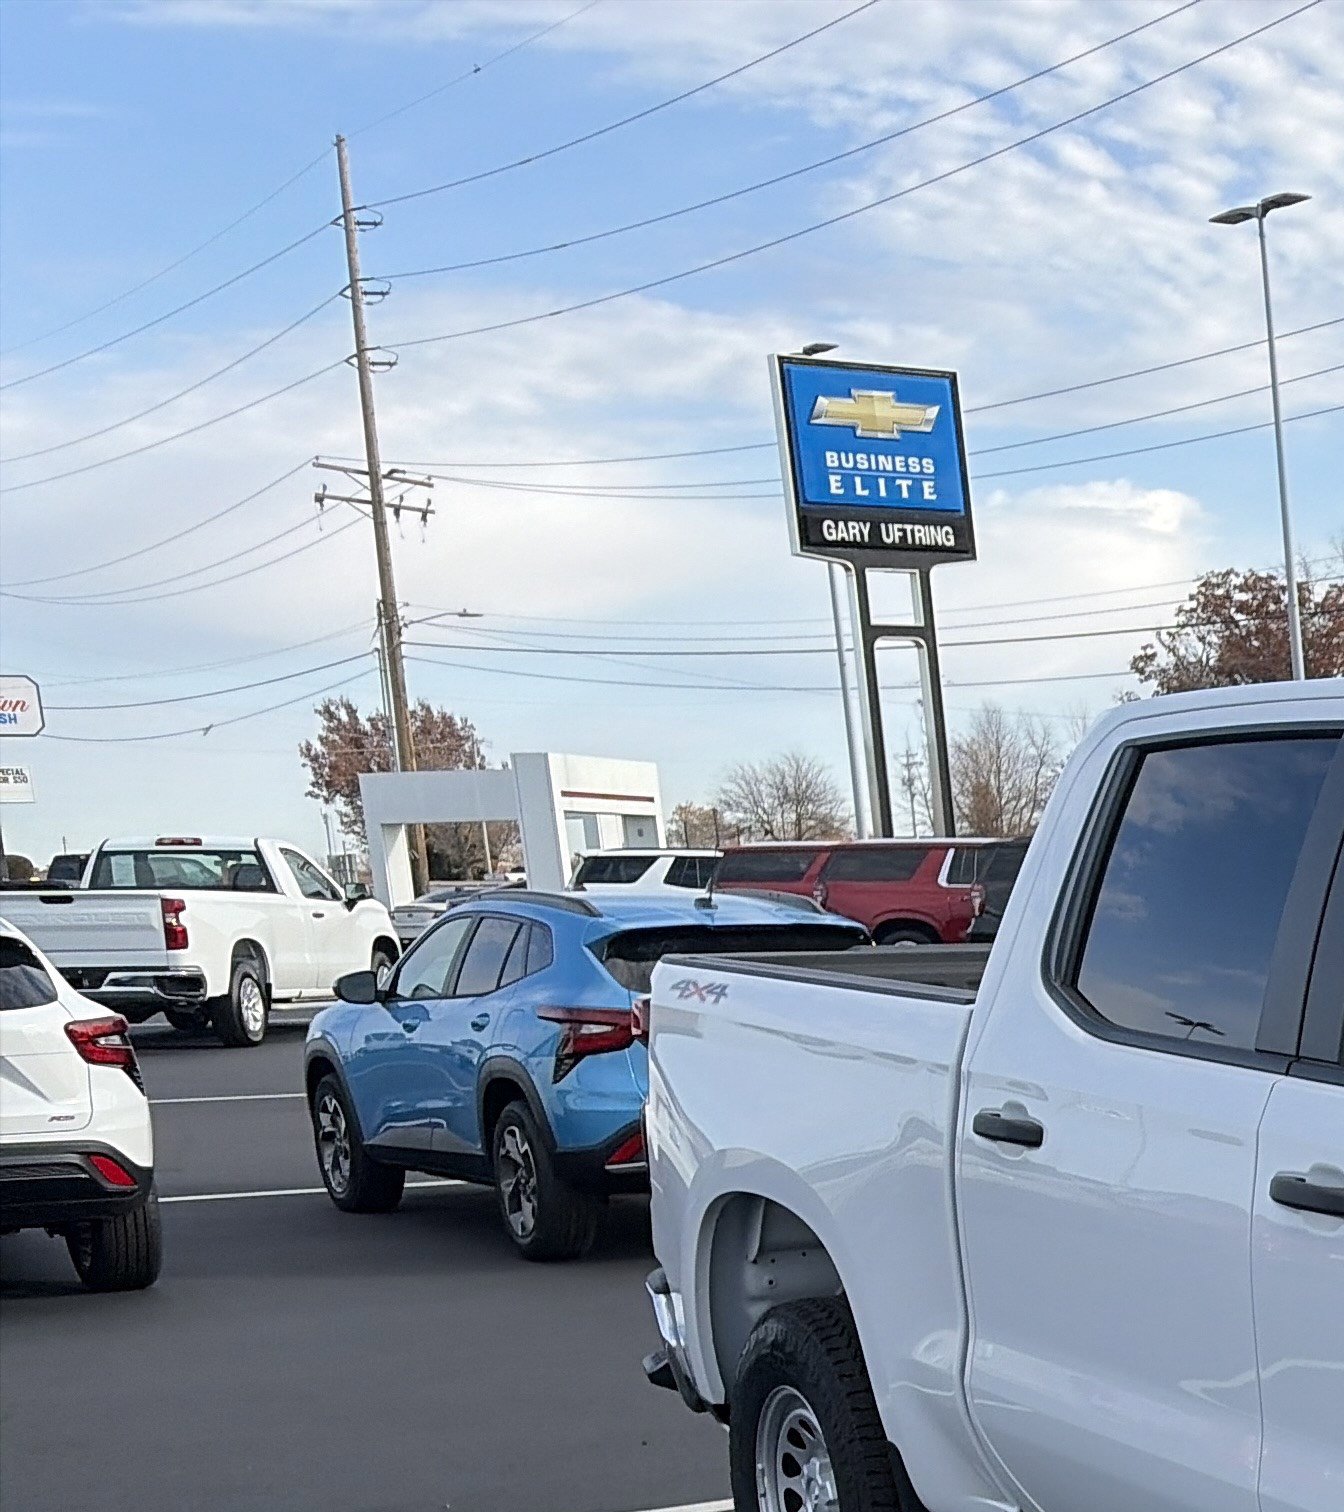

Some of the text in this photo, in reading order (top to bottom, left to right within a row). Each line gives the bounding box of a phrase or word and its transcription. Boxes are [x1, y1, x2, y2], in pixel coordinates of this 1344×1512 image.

[826, 451, 935, 474] BUSINESS
[829, 476, 937, 500] ELITE
[822, 519, 956, 547] GARY UFTRING
